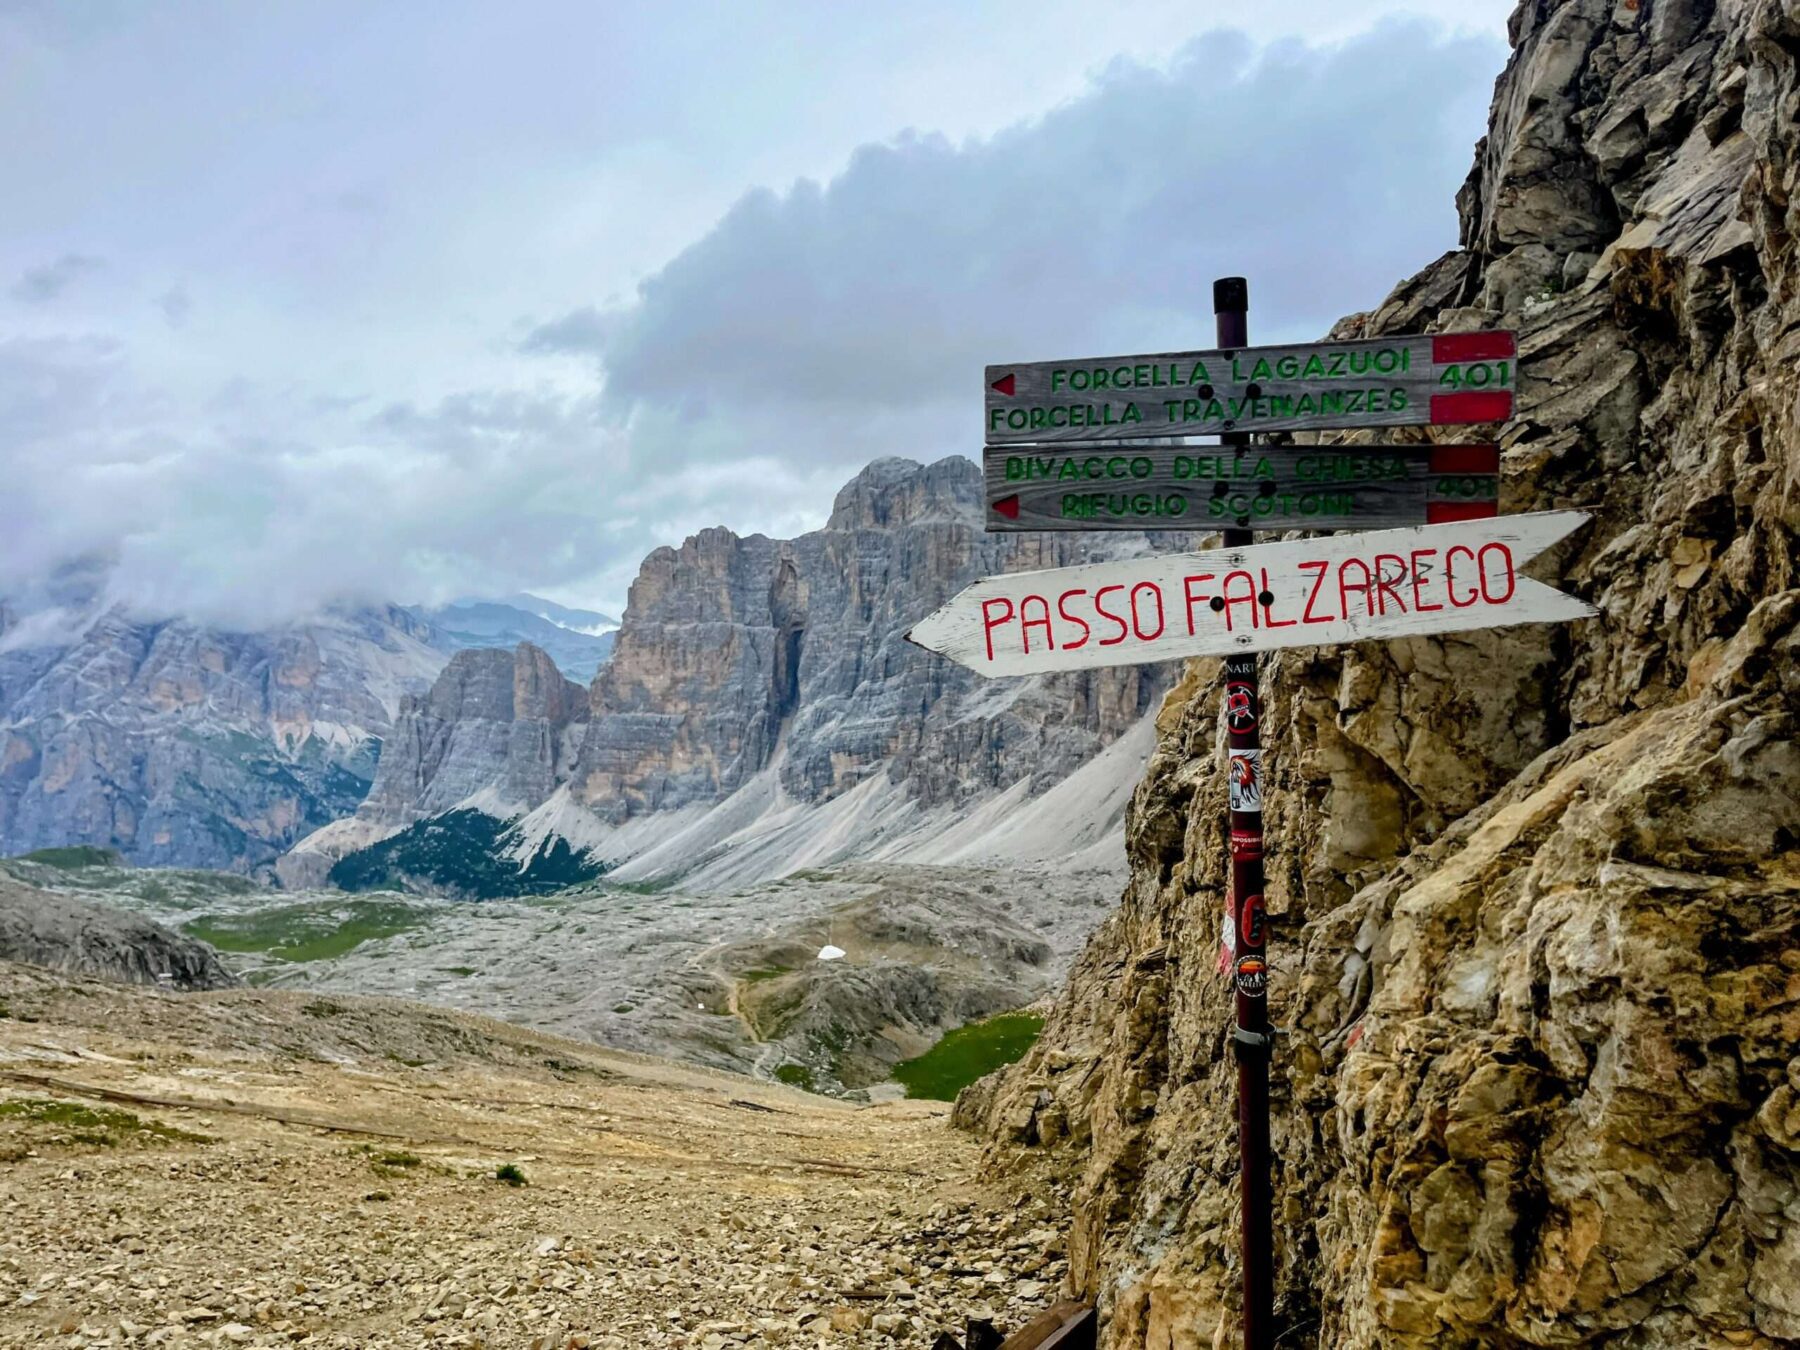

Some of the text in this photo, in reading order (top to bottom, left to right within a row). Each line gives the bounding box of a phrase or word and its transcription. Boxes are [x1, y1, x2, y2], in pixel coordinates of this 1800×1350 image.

[1051, 347, 1410, 394] FORCELLA LAGAZUOI
[1439, 361, 1510, 390] 401
[990, 387, 1409, 431] FORCELLA TRAVENANZES
[1005, 455, 1409, 481] BIVACCO DELLA CHIESA
[1062, 493, 1356, 519] RIFUGIO SCOTONI
[981, 542, 1515, 661] PASSO FALZAREGO
